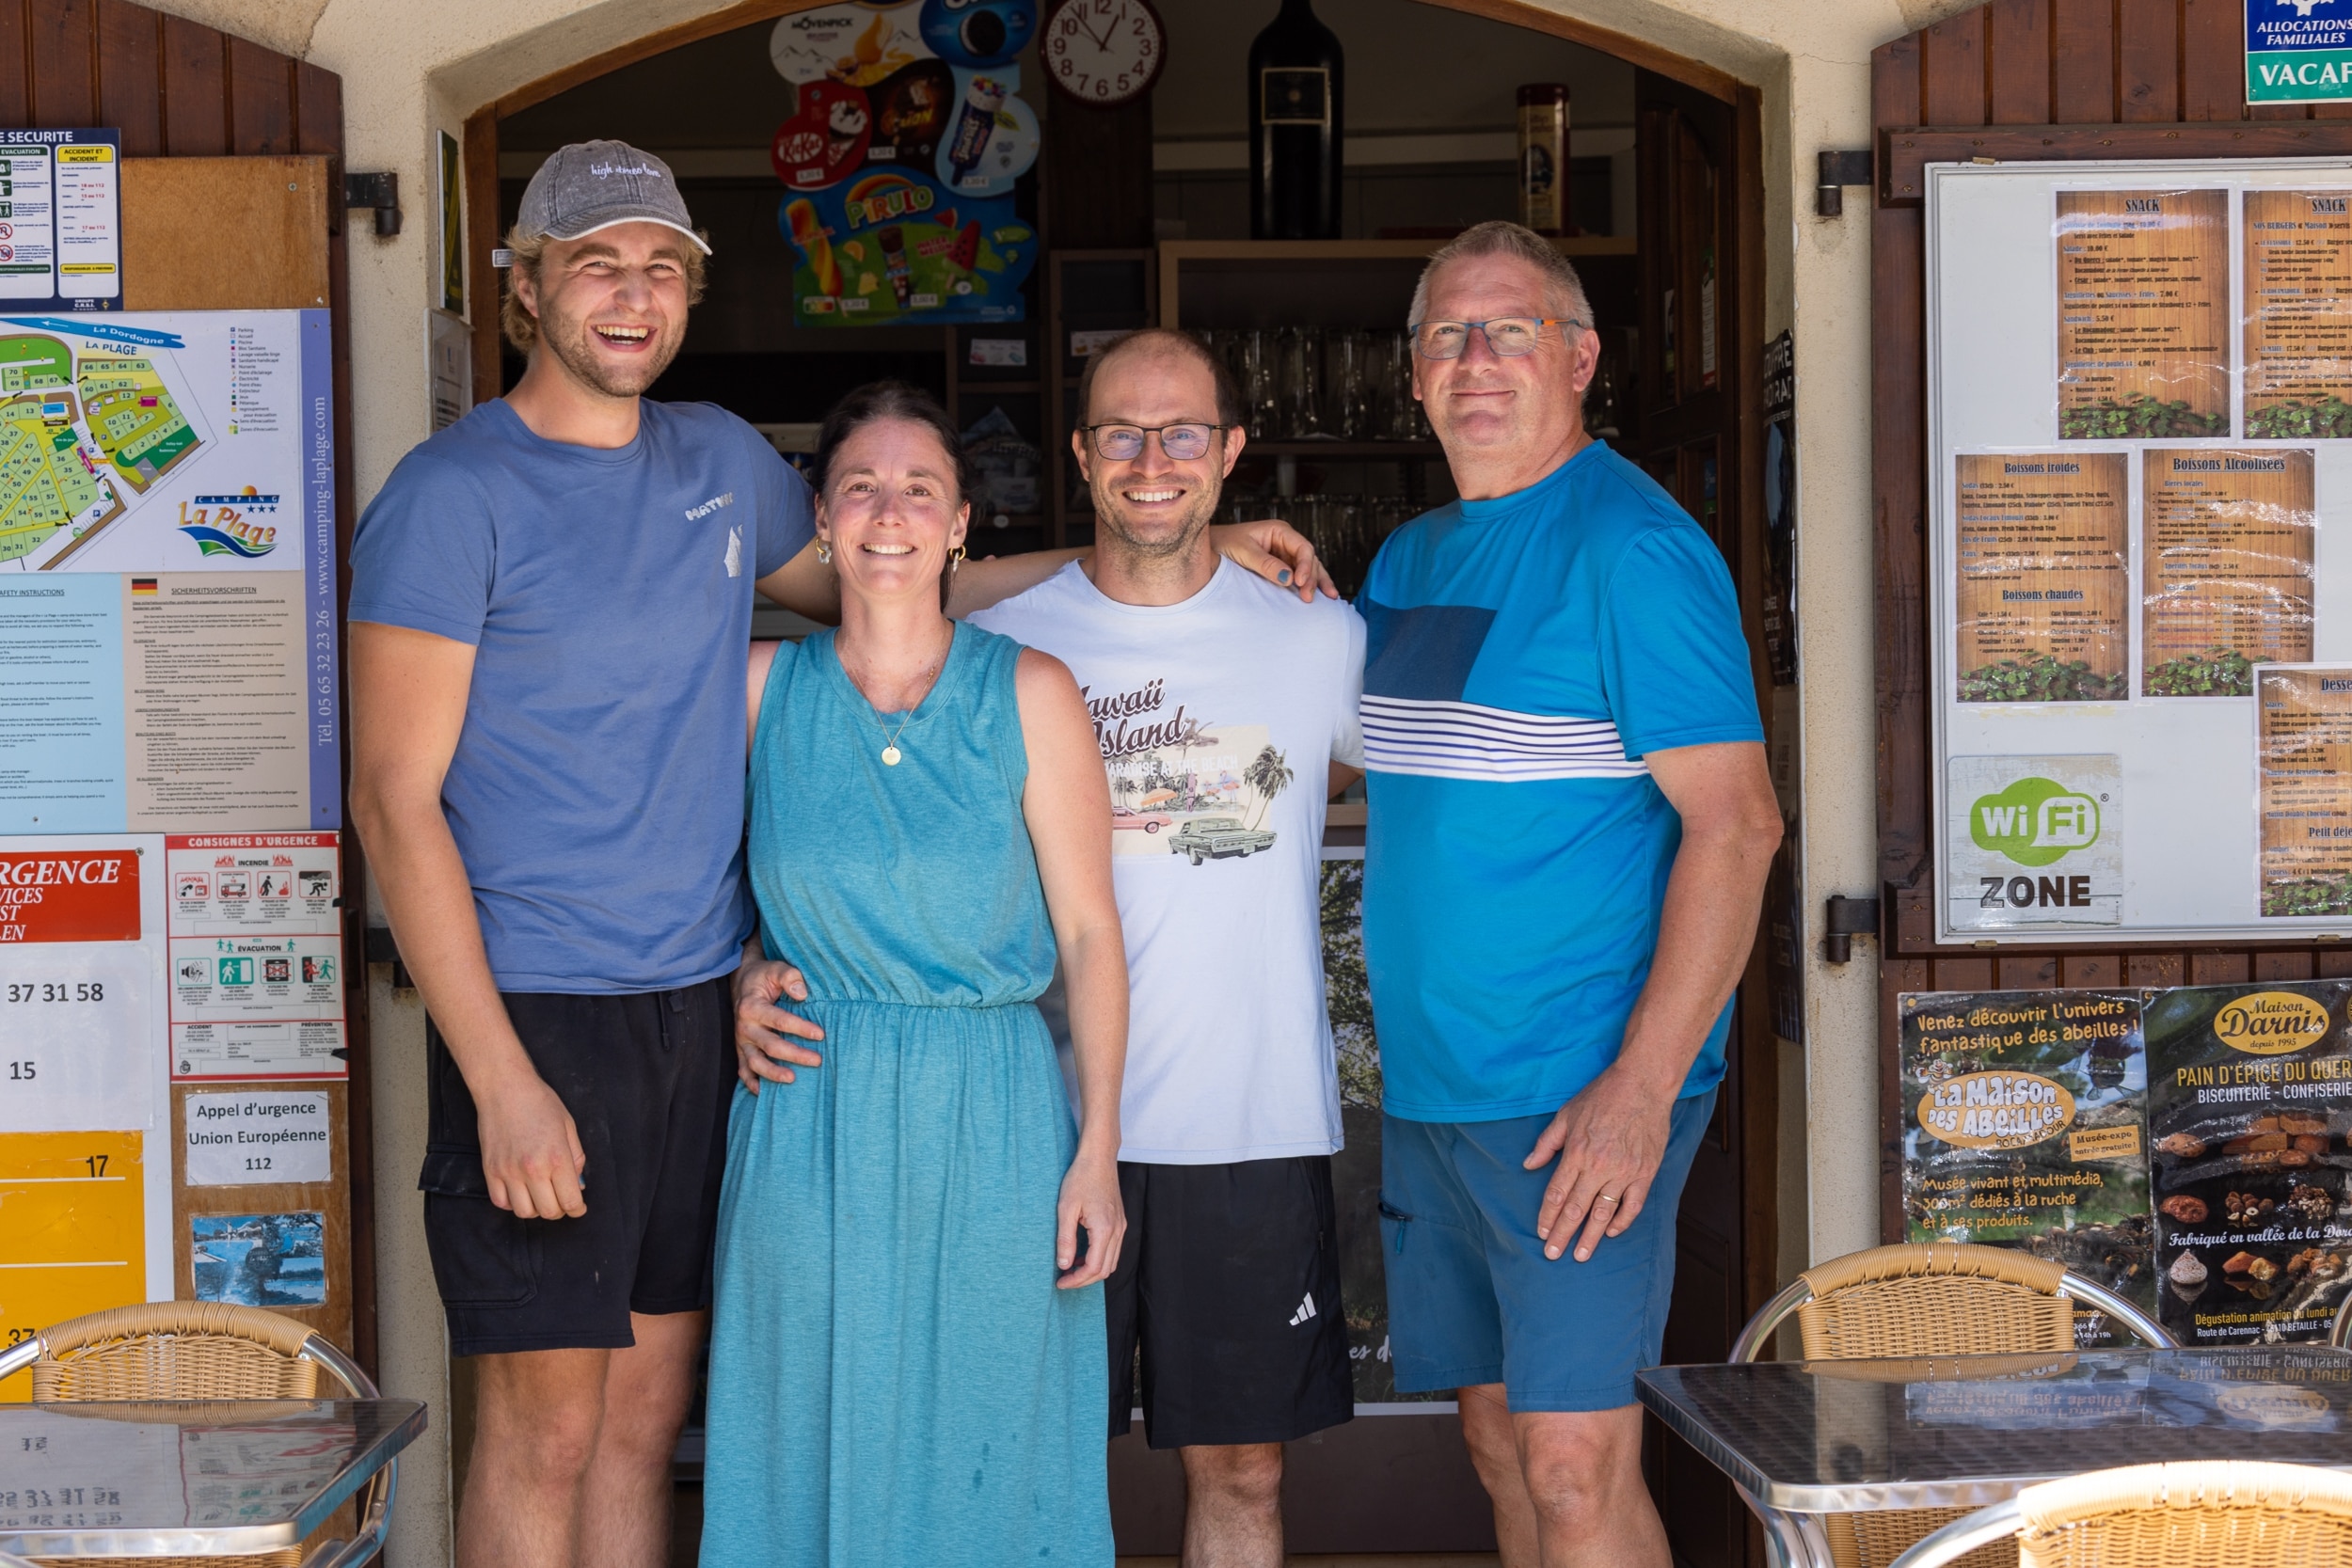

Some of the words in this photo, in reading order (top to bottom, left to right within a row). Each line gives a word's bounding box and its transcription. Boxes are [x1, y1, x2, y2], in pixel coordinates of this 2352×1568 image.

[1095, 0, 1112, 14] 12
[1061, 19, 1077, 36] 10
[1133, 18, 1145, 36] 2
[2256, 19, 2352, 33] ALLOCATIONS
[1054, 38, 1066, 55] 9
[2266, 32, 2346, 45] FAMILIALES
[1139, 39, 1152, 56] 3
[1060, 58, 1073, 76] 8
[1132, 60, 1145, 76] 4
[2259, 62, 2352, 87] VACAF
[1077, 74, 1089, 90] 7
[1096, 79, 1108, 96] 6
[1118, 74, 1130, 91] 5
[8, 132, 73, 143] SECURITE
[845, 185, 934, 230] PIRULO
[2125, 198, 2160, 213] SNACK
[2312, 198, 2346, 213] SNACK
[110, 328, 165, 345] Dordogne
[86, 341, 99, 349] LA
[103, 343, 137, 356] PLAGE
[2005, 463, 2044, 473] Boissons
[2173, 457, 2220, 470] Boissons
[199, 496, 278, 504] CAMPING
[311, 396, 332, 595] www.camping-laplage.com
[178, 500, 208, 526] La
[212, 506, 277, 546] Plage
[2002, 590, 2042, 600] Boissons
[2045, 589, 2084, 600] chaudes
[316, 610, 330, 627] 26
[316, 632, 330, 649] 23
[317, 654, 331, 671] 32
[317, 676, 331, 693] 65
[318, 699, 332, 715] 05
[318, 717, 333, 746] Tél.
[2309, 827, 2330, 838] Petit
[188, 837, 251, 847] CONSIGNES
[256, 836, 318, 846] D'URGENCE
[1979, 876, 2091, 909] ZONE
[0, 925, 26, 941] EN
[8, 984, 35, 1003] 37
[42, 983, 69, 1003] 31
[76, 983, 103, 1002] 58
[2249, 1000, 2304, 1014] Maison
[1917, 1015, 1964, 1032] Venez
[1970, 1007, 2047, 1029] découvrir
[2053, 1002, 2124, 1020] l'univers
[2220, 1007, 2326, 1037] Darnis
[1920, 1032, 2023, 1054] fantastique
[2028, 1027, 2057, 1044] des
[2063, 1021, 2128, 1041] abeilles
[2249, 1040, 2275, 1051] depuis
[2278, 1038, 2296, 1047] 1995
[9, 1062, 36, 1080] 15
[2177, 1066, 2214, 1086] PAIN
[2219, 1061, 2280, 1085] D'ÉPICE
[2284, 1062, 2305, 1082] DU
[2311, 1060, 2352, 1080] QUER
[2198, 1085, 2271, 1104] BISCUITERIE
[2283, 1082, 2352, 1099] CONFISERIE
[197, 1103, 240, 1119] Appel
[244, 1101, 317, 1118] d'urgence
[188, 1131, 233, 1146] Union
[237, 1128, 326, 1146] Européenne
[2076, 1132, 2133, 1145] Musée-expo
[2101, 1144, 2133, 1155] gratuite
[85, 1155, 109, 1179] 17
[245, 1157, 272, 1171] 112
[1922, 1177, 1965, 1192] Musée
[1970, 1175, 2009, 1189] vivant
[2012, 1176, 2026, 1188] et
[2029, 1171, 2105, 1189] multimédia,
[1969, 1193, 2010, 1208] dédiés
[2013, 1191, 2022, 1206] à
[2025, 1190, 2038, 1206] la
[2041, 1192, 2076, 1206] ruche
[1922, 1215, 1936, 1228] et
[1940, 1213, 1948, 1228] à
[1952, 1218, 1973, 1227] ses
[1977, 1214, 2033, 1232] produits.
[2169, 1231, 2228, 1248] Fabriqué
[2230, 1234, 2245, 1243] en
[2247, 1227, 2286, 1243] vallée
[2288, 1227, 2303, 1241] de
[2305, 1226, 2320, 1239] la
[2195, 1313, 2248, 1327] Dégustation
[2249, 1310, 2292, 1323] animation
[2306, 1307, 2328, 1318] lundi
[2197, 1328, 2217, 1338] Route
[2218, 1327, 2227, 1336] de
[2229, 1326, 2260, 1335] Carennac
[2324, 1321, 2332, 1329] 05
